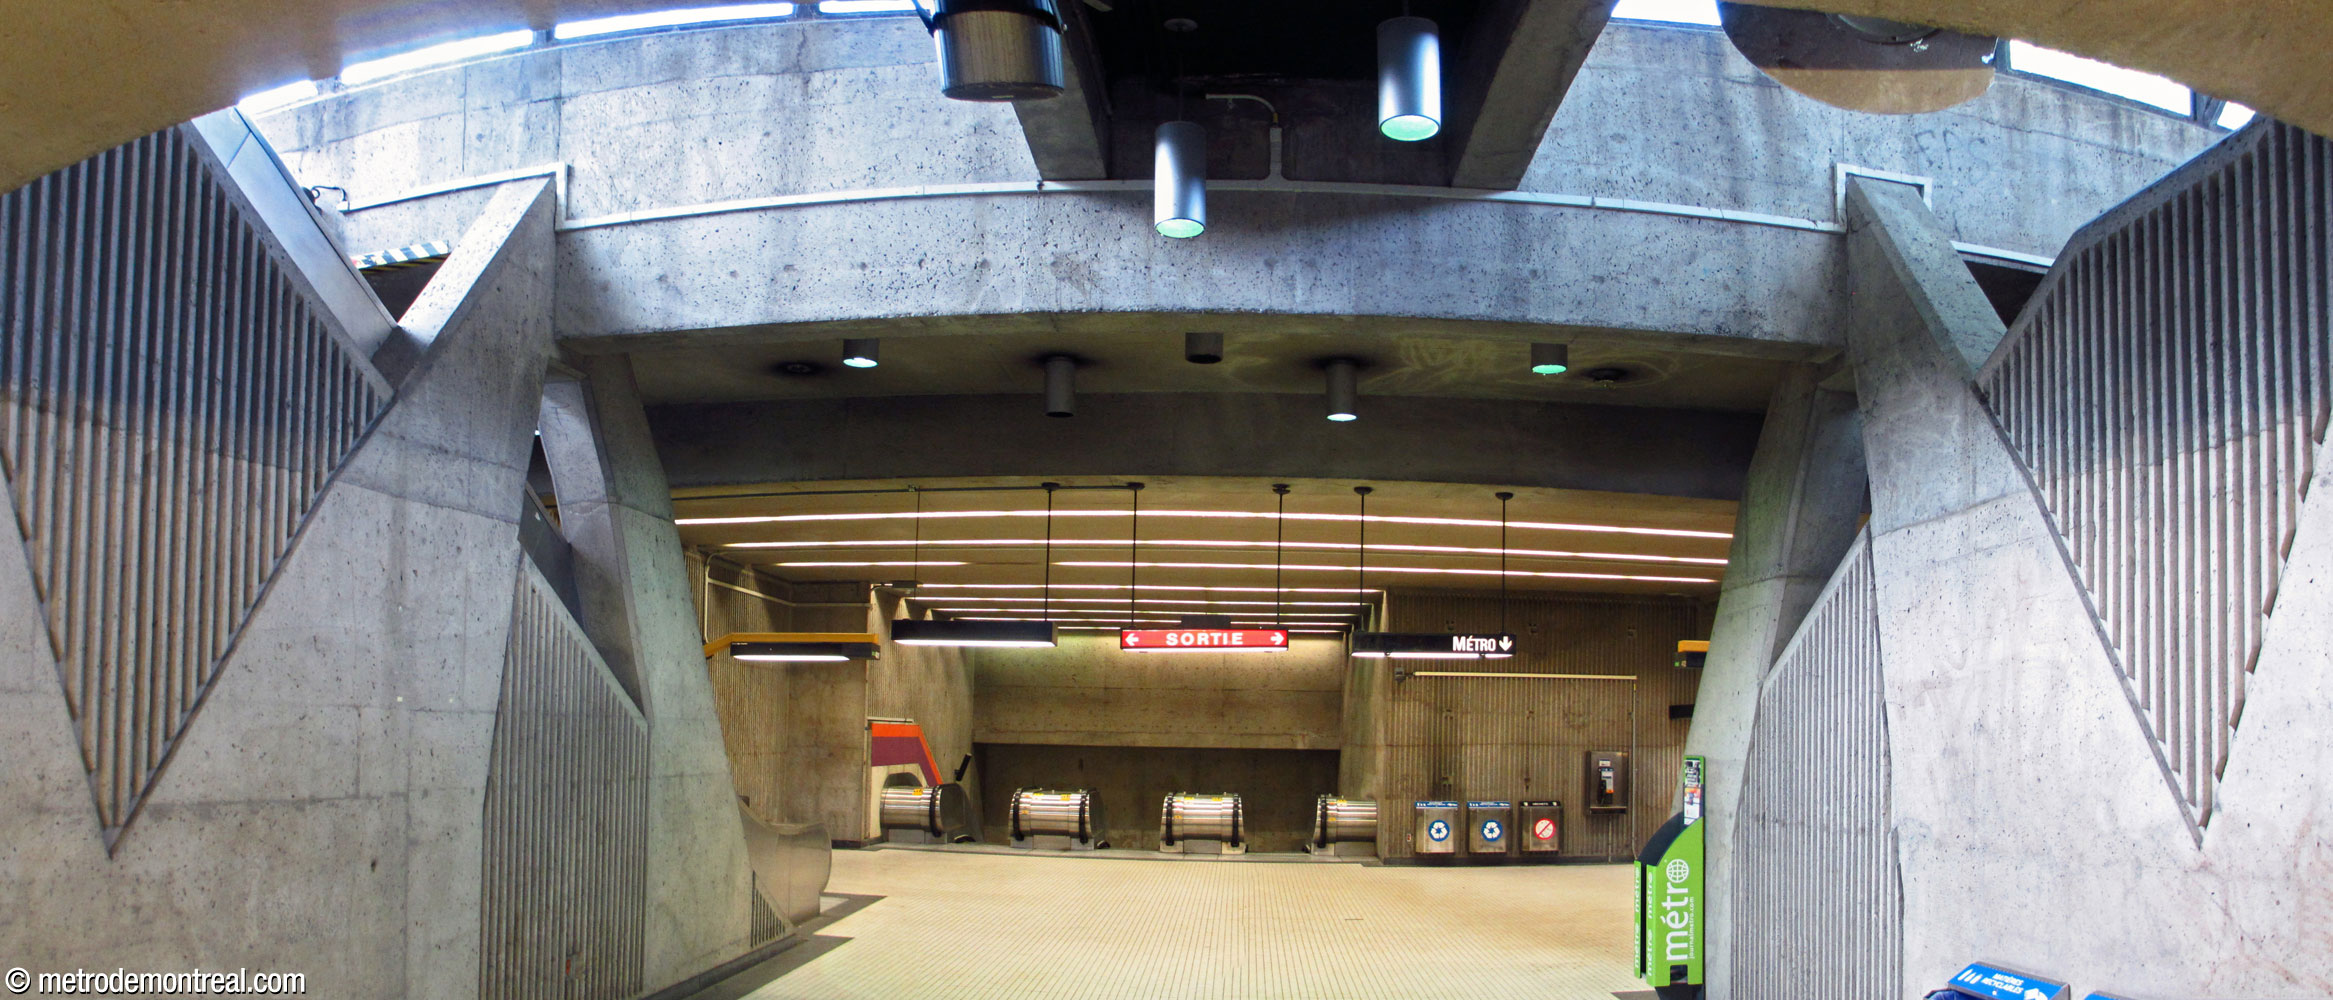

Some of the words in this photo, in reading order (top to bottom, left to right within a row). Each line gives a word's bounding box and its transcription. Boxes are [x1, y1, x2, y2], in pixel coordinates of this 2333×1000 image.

[1165, 632, 1244, 646] SORTIE
[1452, 635, 1497, 652] MÉTRO
[1660, 858, 1690, 961] métro
